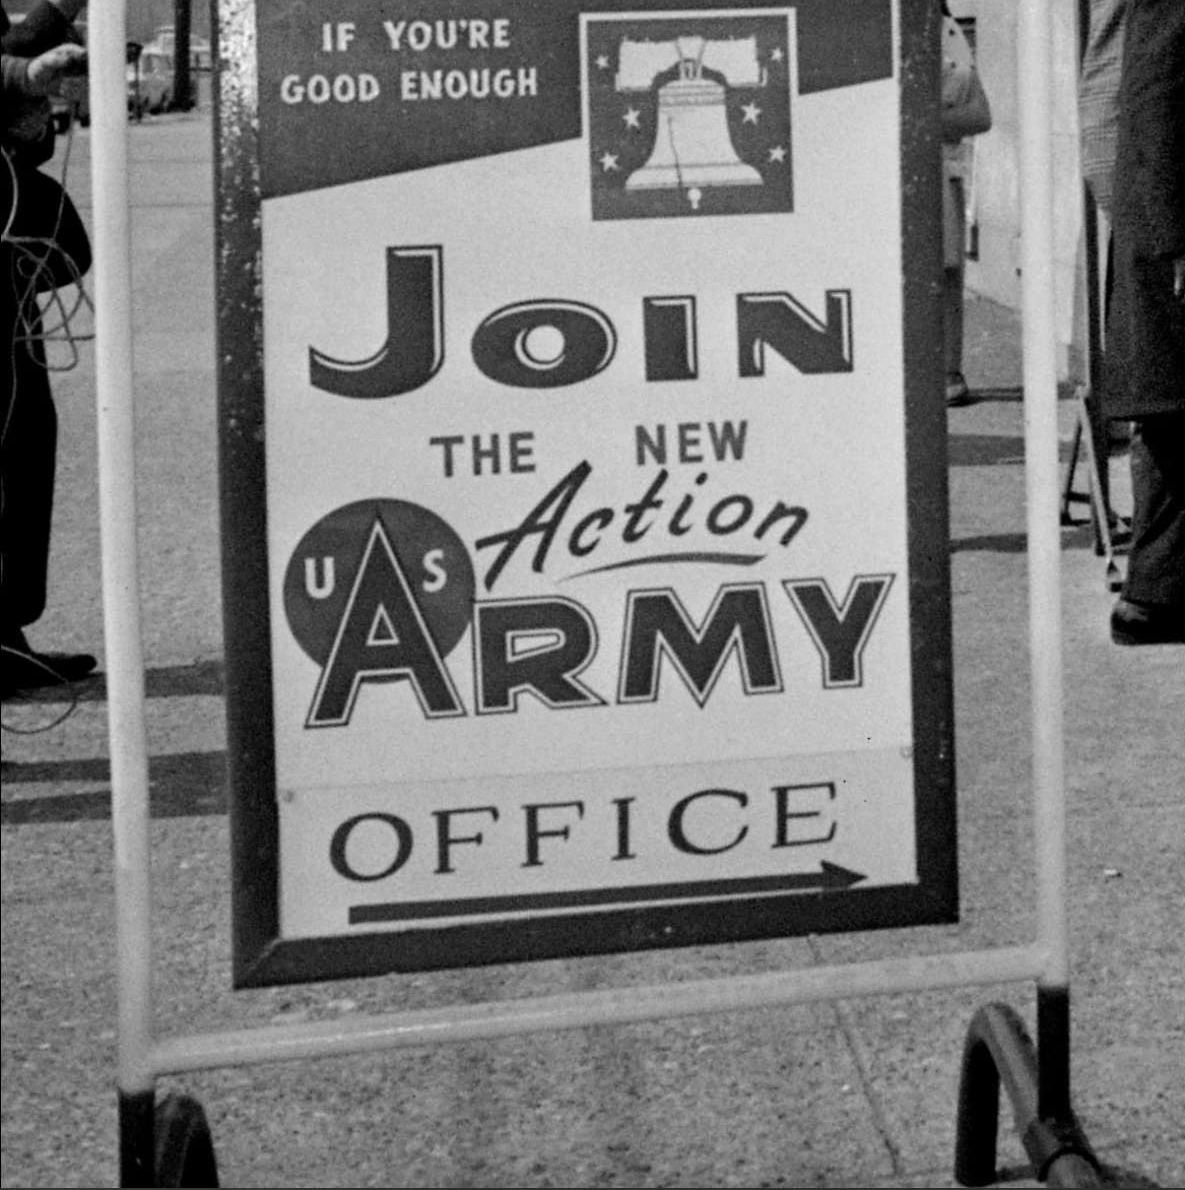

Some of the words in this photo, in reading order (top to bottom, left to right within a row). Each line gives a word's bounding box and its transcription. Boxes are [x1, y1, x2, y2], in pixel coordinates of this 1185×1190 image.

[280, 73, 380, 104] GOOD
[401, 67, 538, 101] ENOUGH
[322, 22, 355, 52] IF
[383, 18, 511, 51] YOU'RE
[309, 244, 854, 400] JOIN
[430, 431, 537, 478] THE
[634, 420, 749, 465] NEW
[476, 459, 810, 592] Action
[304, 510, 896, 730] ARMY
[329, 781, 840, 883] OFFICE
